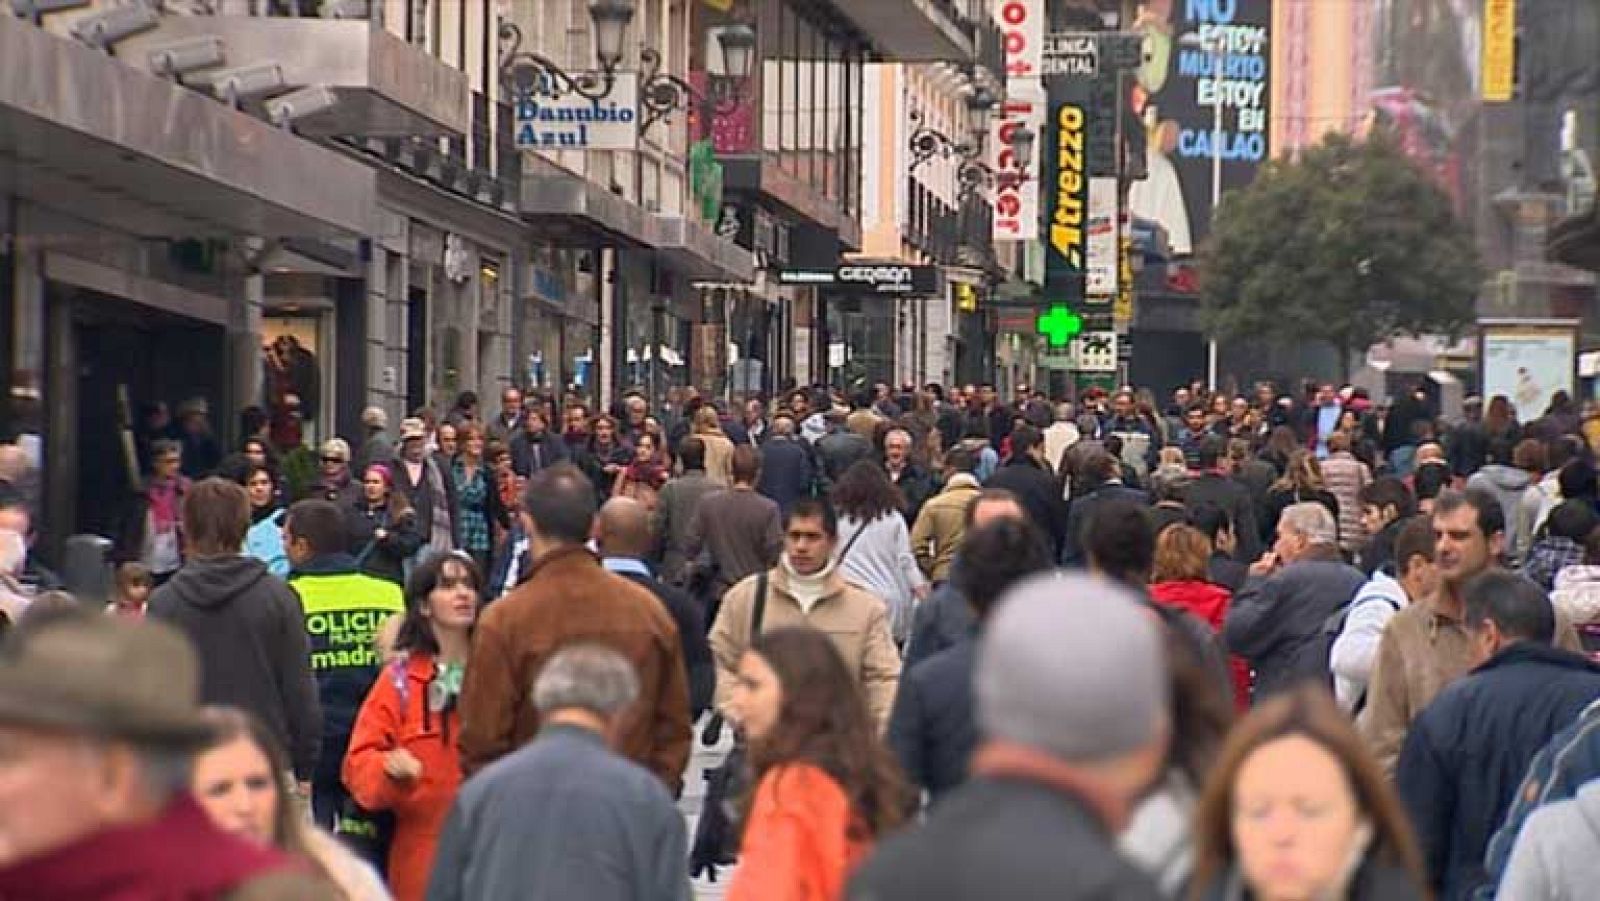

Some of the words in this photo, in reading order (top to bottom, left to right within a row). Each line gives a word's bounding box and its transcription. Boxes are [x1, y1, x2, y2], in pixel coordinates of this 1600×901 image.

[1184, 0, 1236, 23] NO
[1001, 0, 1032, 77] oot
[518, 98, 634, 122] Danubio
[518, 123, 588, 146] Azul
[307, 611, 388, 635] OLICI
